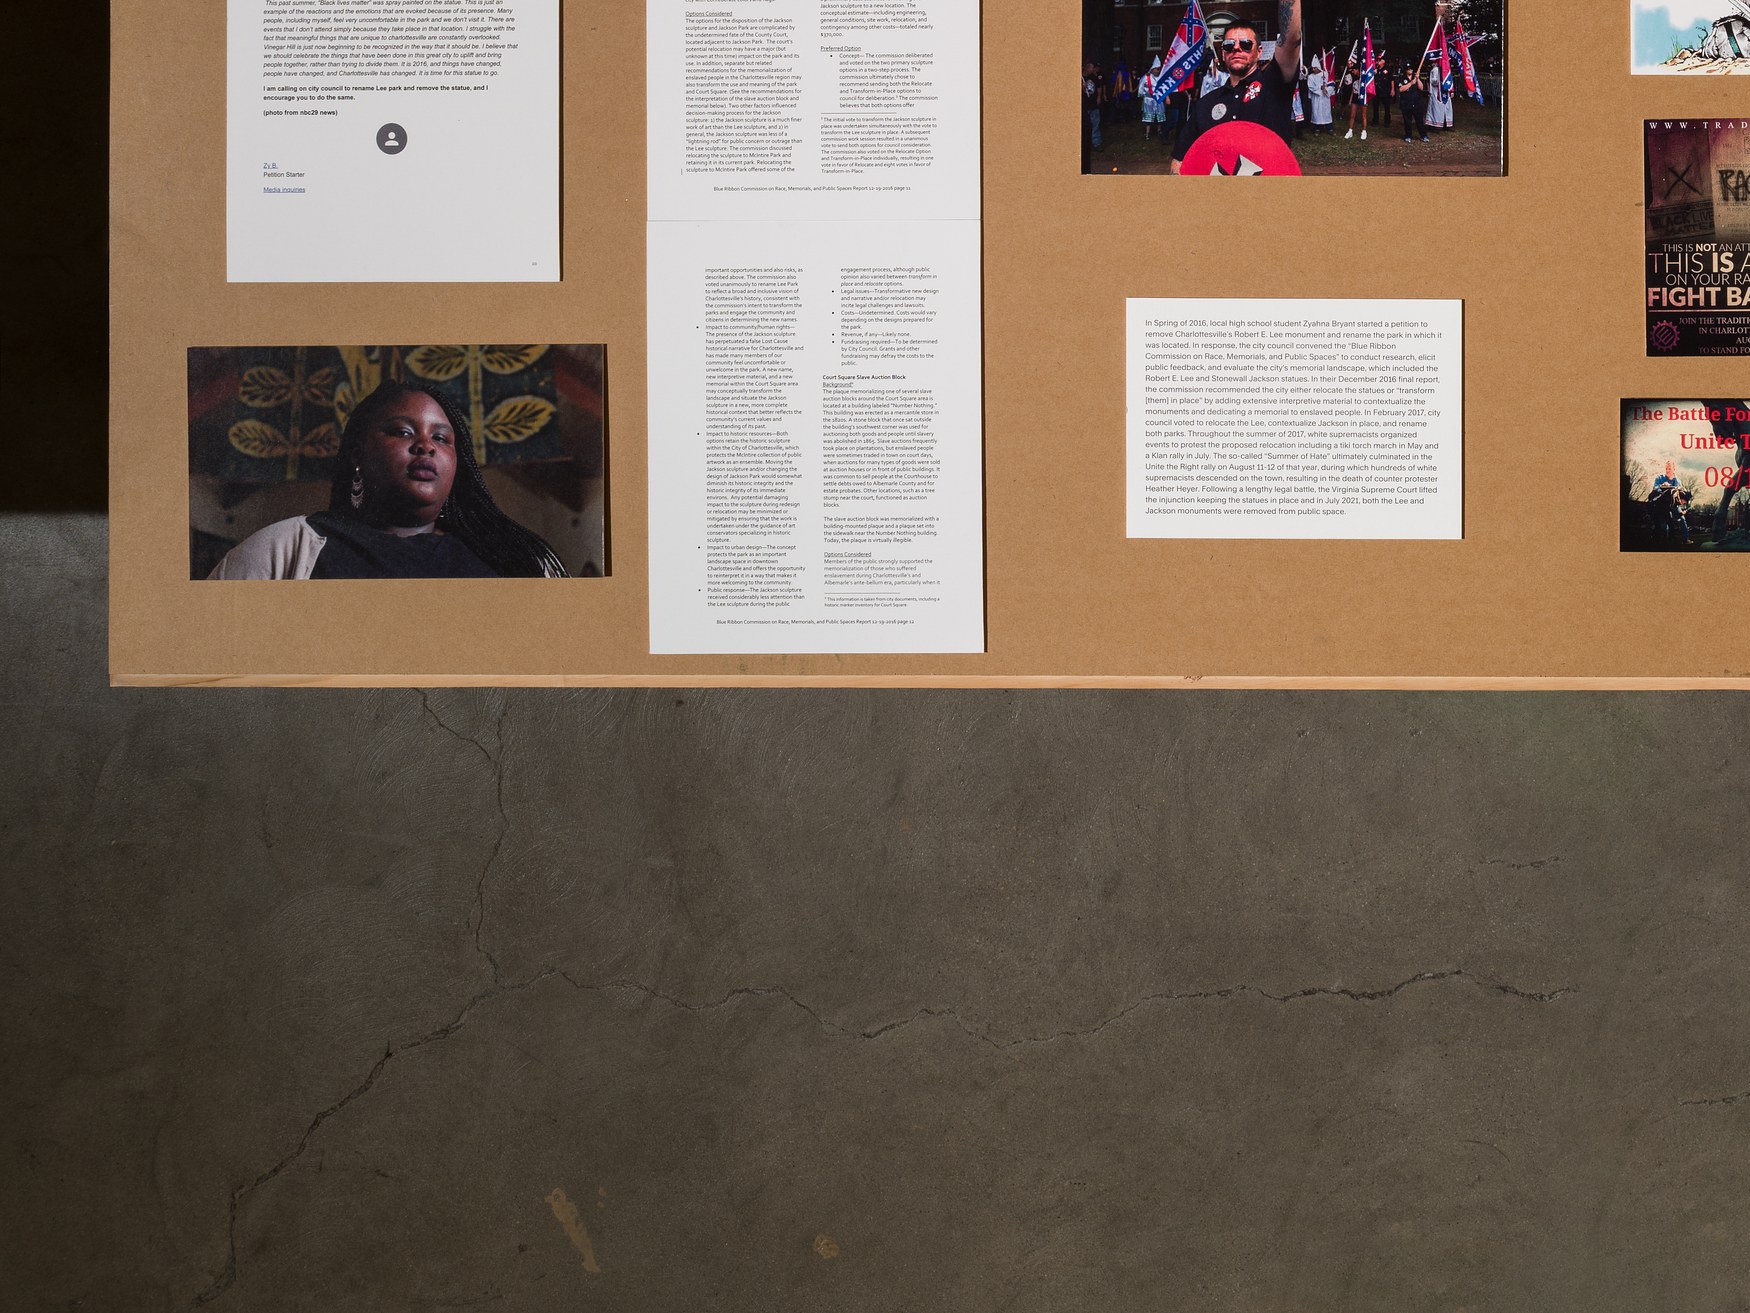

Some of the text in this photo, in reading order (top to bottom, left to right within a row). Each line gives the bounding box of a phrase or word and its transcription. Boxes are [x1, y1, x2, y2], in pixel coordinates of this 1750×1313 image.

[263, 109, 283, 117] (photo
[300, 108, 319, 116] nbc29
[319, 109, 338, 117] news)
[1662, 243, 1683, 253] THIS
[1685, 243, 1694, 253] IS
[1695, 243, 1717, 252] NOT
[1719, 242, 1733, 252] AN
[1648, 252, 1704, 274] THIS
[1712, 252, 1735, 273] IS
[1665, 273, 1688, 286] ON
[1691, 273, 1731, 286] YOUR
[1648, 287, 1721, 307] FIGHT
[1678, 316, 1697, 326] JOIN
[1699, 316, 1715, 326] THE
[1699, 326, 1707, 335] IN
[1711, 345, 1738, 355] STAND
[1632, 406, 1663, 421] The
[1668, 406, 1721, 421] Battle
[1680, 433, 1735, 450] Unite
[1145, 506, 1346, 517] Jackson monuments were removed from public space.
